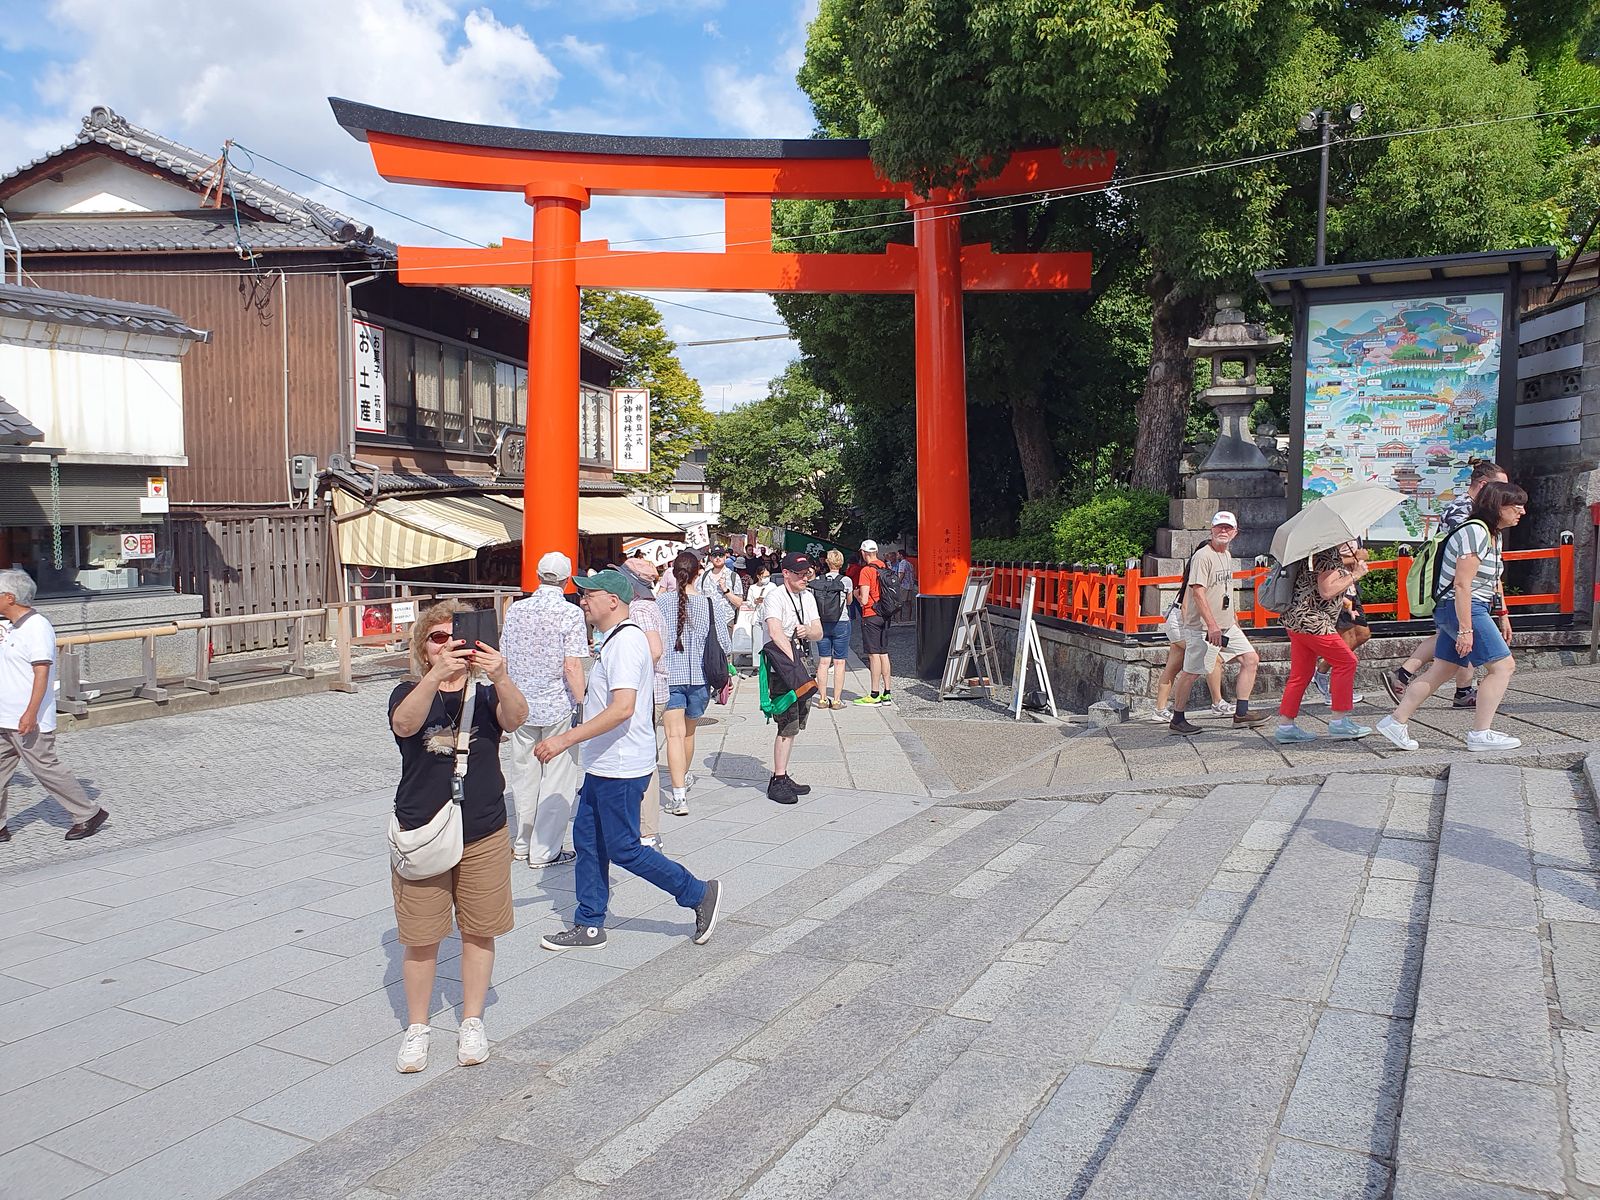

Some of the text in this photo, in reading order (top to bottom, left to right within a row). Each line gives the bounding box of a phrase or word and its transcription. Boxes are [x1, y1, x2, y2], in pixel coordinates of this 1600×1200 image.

[359, 329, 371, 422] お土産
[373, 335, 382, 424] お菓子・玩具
